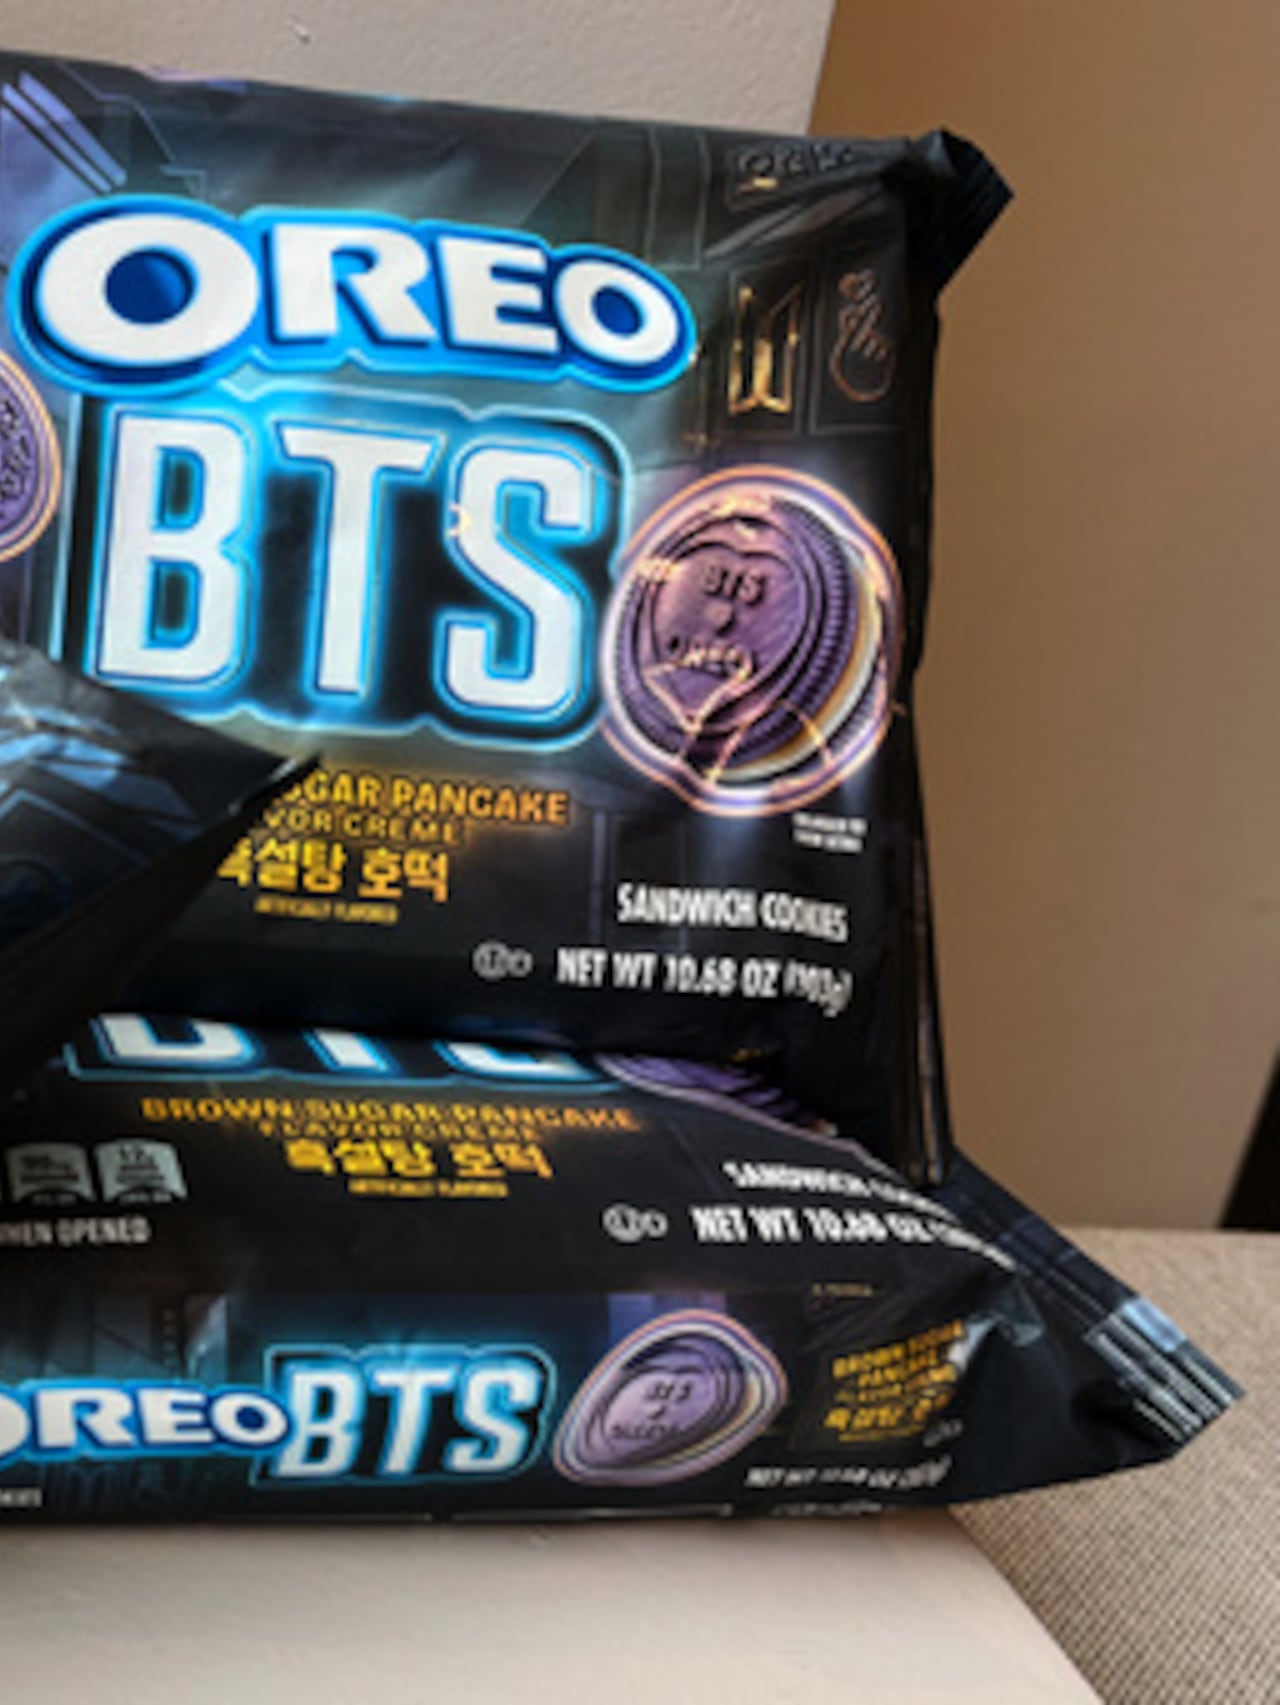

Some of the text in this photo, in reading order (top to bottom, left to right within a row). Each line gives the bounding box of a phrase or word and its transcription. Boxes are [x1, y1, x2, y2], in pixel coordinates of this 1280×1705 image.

[34, 211, 682, 370] OREO
[96, 411, 586, 713] BTS
[391, 777, 570, 826] PANCAKE
[357, 846, 449, 904] 호떡
[616, 882, 849, 943] SANDWICH COOKIES
[557, 946, 608, 988] NET
[611, 951, 658, 990] WT
[663, 954, 739, 999] 10.68
[740, 957, 782, 999] OZ
[141, 1098, 641, 1132] BROWN SUGAR PANCAKE
[55, 1215, 152, 1247] OPENED
[691, 1205, 748, 1242] NET
[748, 1205, 802, 1242] WT
[277, 1366, 540, 1477] BTS
